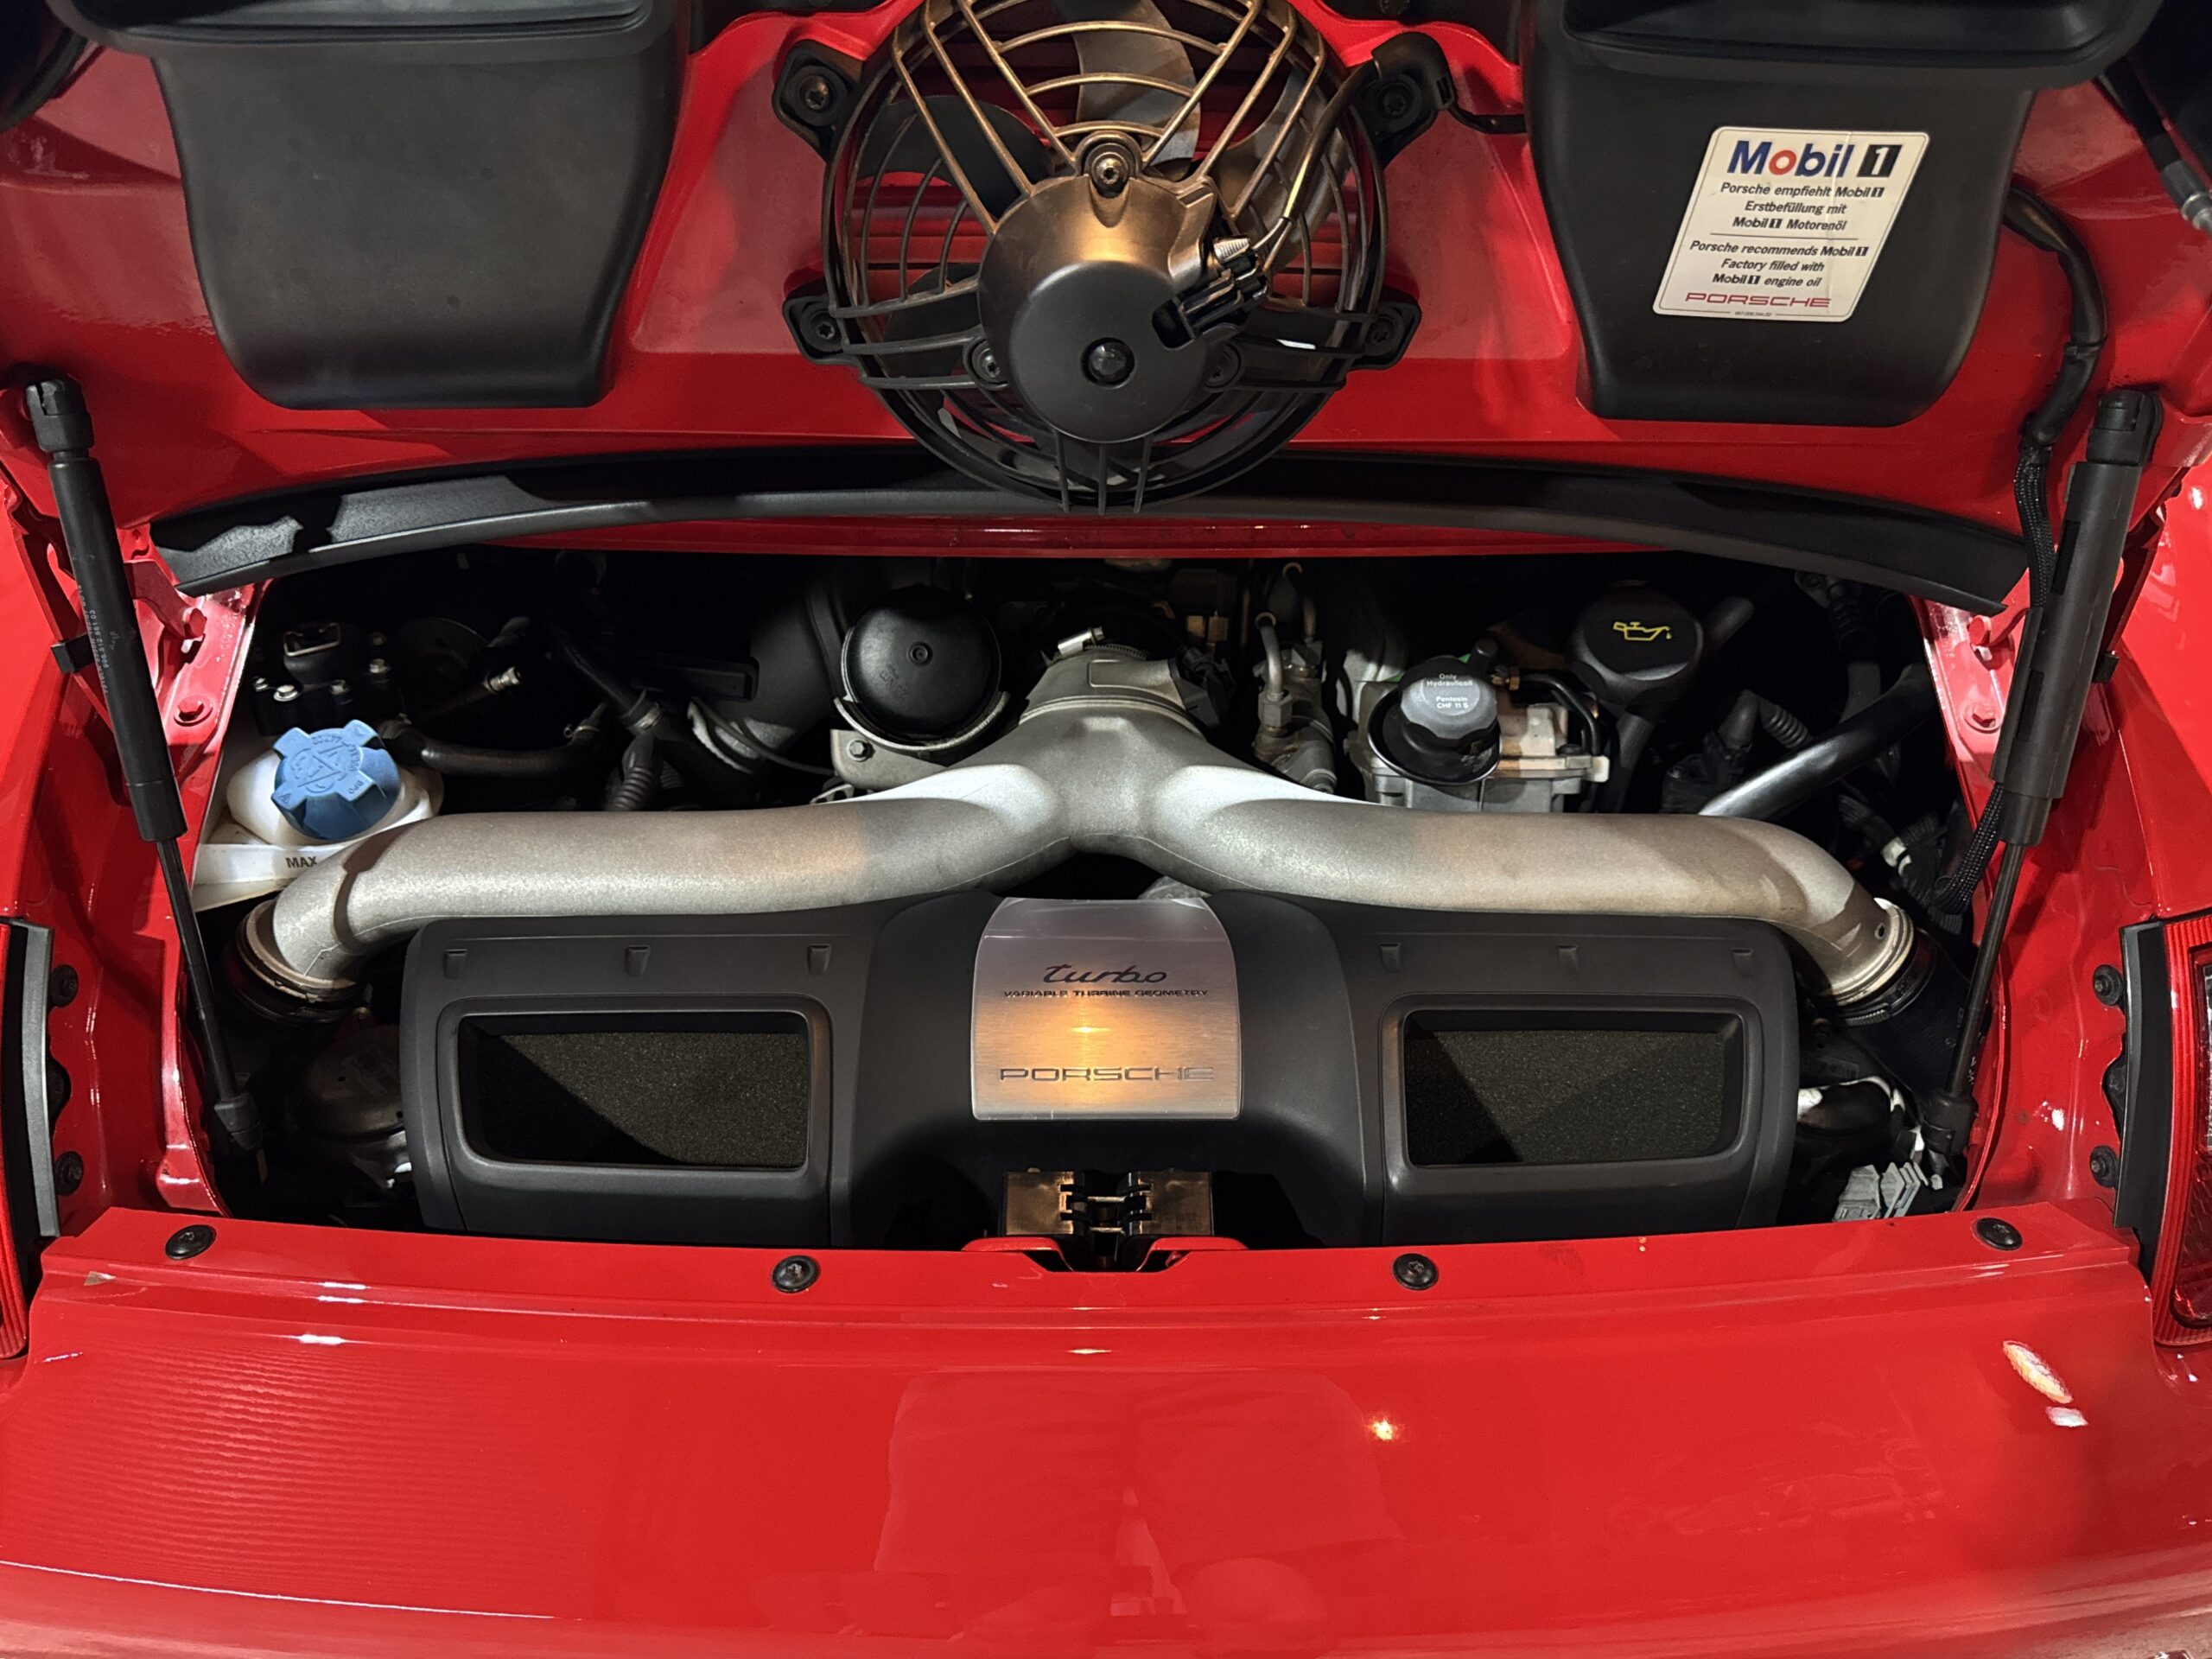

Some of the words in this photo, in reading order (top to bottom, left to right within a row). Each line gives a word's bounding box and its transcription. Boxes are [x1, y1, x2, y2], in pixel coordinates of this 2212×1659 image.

[1726, 140, 1855, 178] Mobil
[1720, 181, 1770, 196] Porsche
[1774, 185, 1832, 199] empfiehlt
[1745, 200, 1823, 215] Erstbefüllung
[1827, 204, 1847, 215] mit
[1786, 219, 1847, 232] Motorenöl
[1689, 240, 1739, 254] Porsche
[1740, 244, 1818, 257] recommends
[1720, 257, 1767, 272] Factory
[1770, 258, 1799, 271] filled
[1801, 260, 1826, 272] with
[1764, 276, 1804, 289] engine
[1806, 276, 1823, 288] oil
[1685, 292, 1832, 308] PORSCHE
[286, 856, 318, 868] MAX
[1043, 963, 1166, 983] turbo
[1004, 989, 1069, 999] VARIABLE
[1072, 989, 1131, 998] TURBINE
[1134, 988, 1209, 998] GEOMETRY
[1000, 1067, 1214, 1082] PORSCHE
